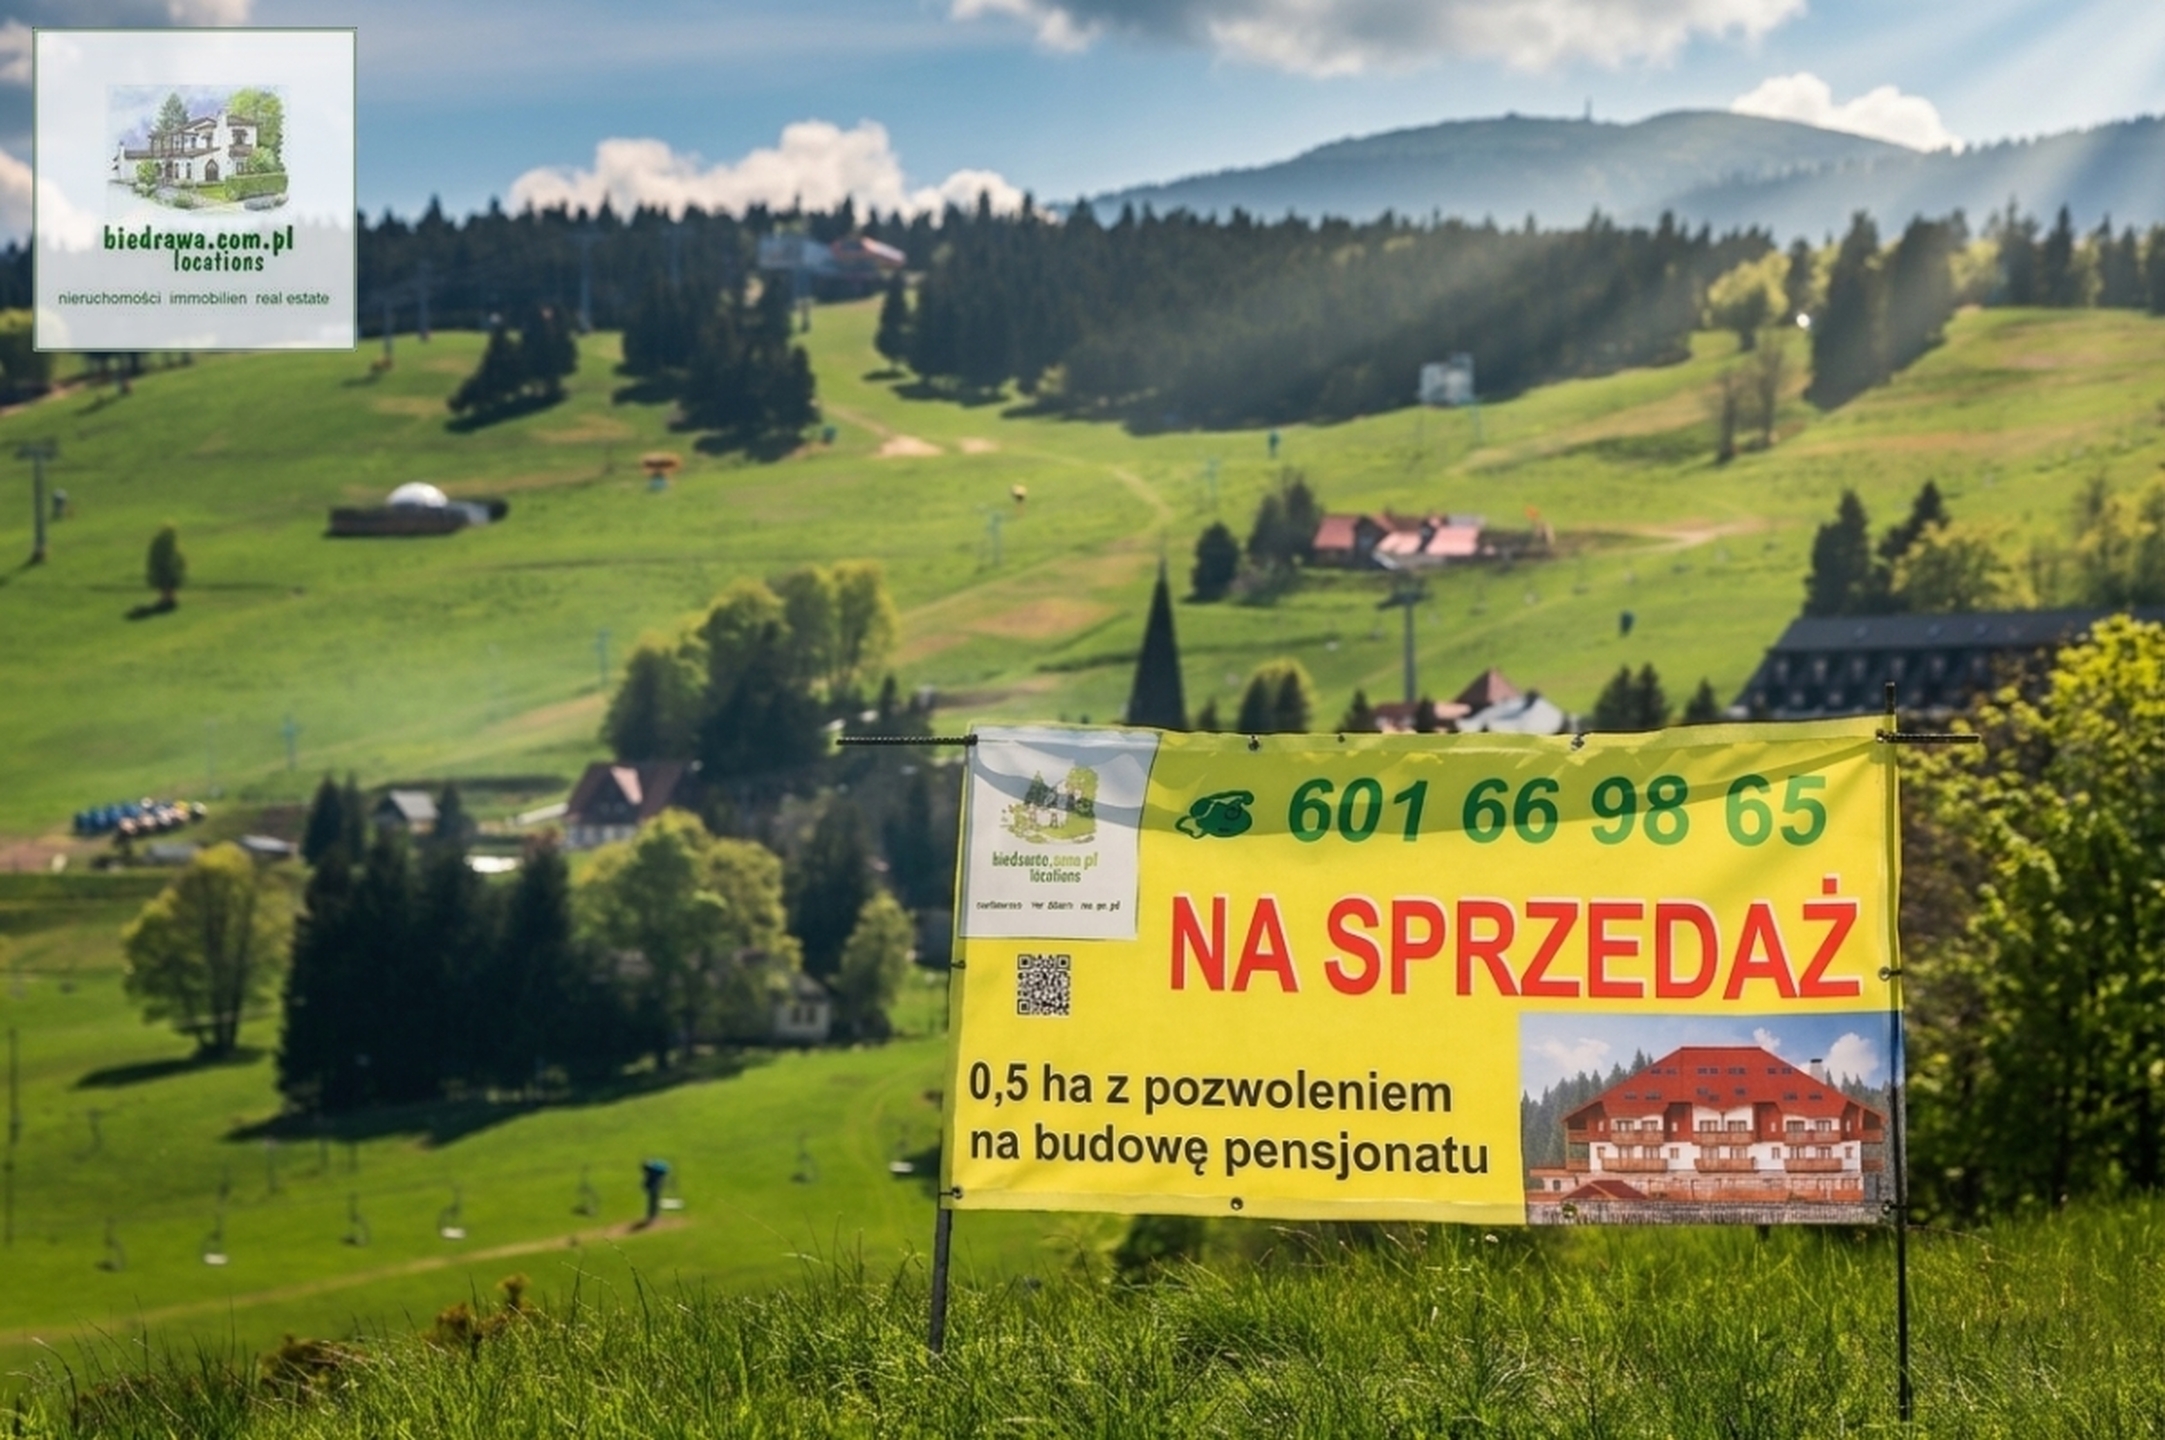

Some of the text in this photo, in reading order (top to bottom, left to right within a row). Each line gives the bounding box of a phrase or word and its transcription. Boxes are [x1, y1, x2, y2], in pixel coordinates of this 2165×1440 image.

[1287, 774, 1829, 847] 601 66 98 65
[1170, 875, 1862, 1000] NA SPRZEDAŻ
[969, 1061, 1453, 1114] 0,5 ha z pozwoleniem
[970, 1123, 1490, 1180] na budowę pensjonatu
